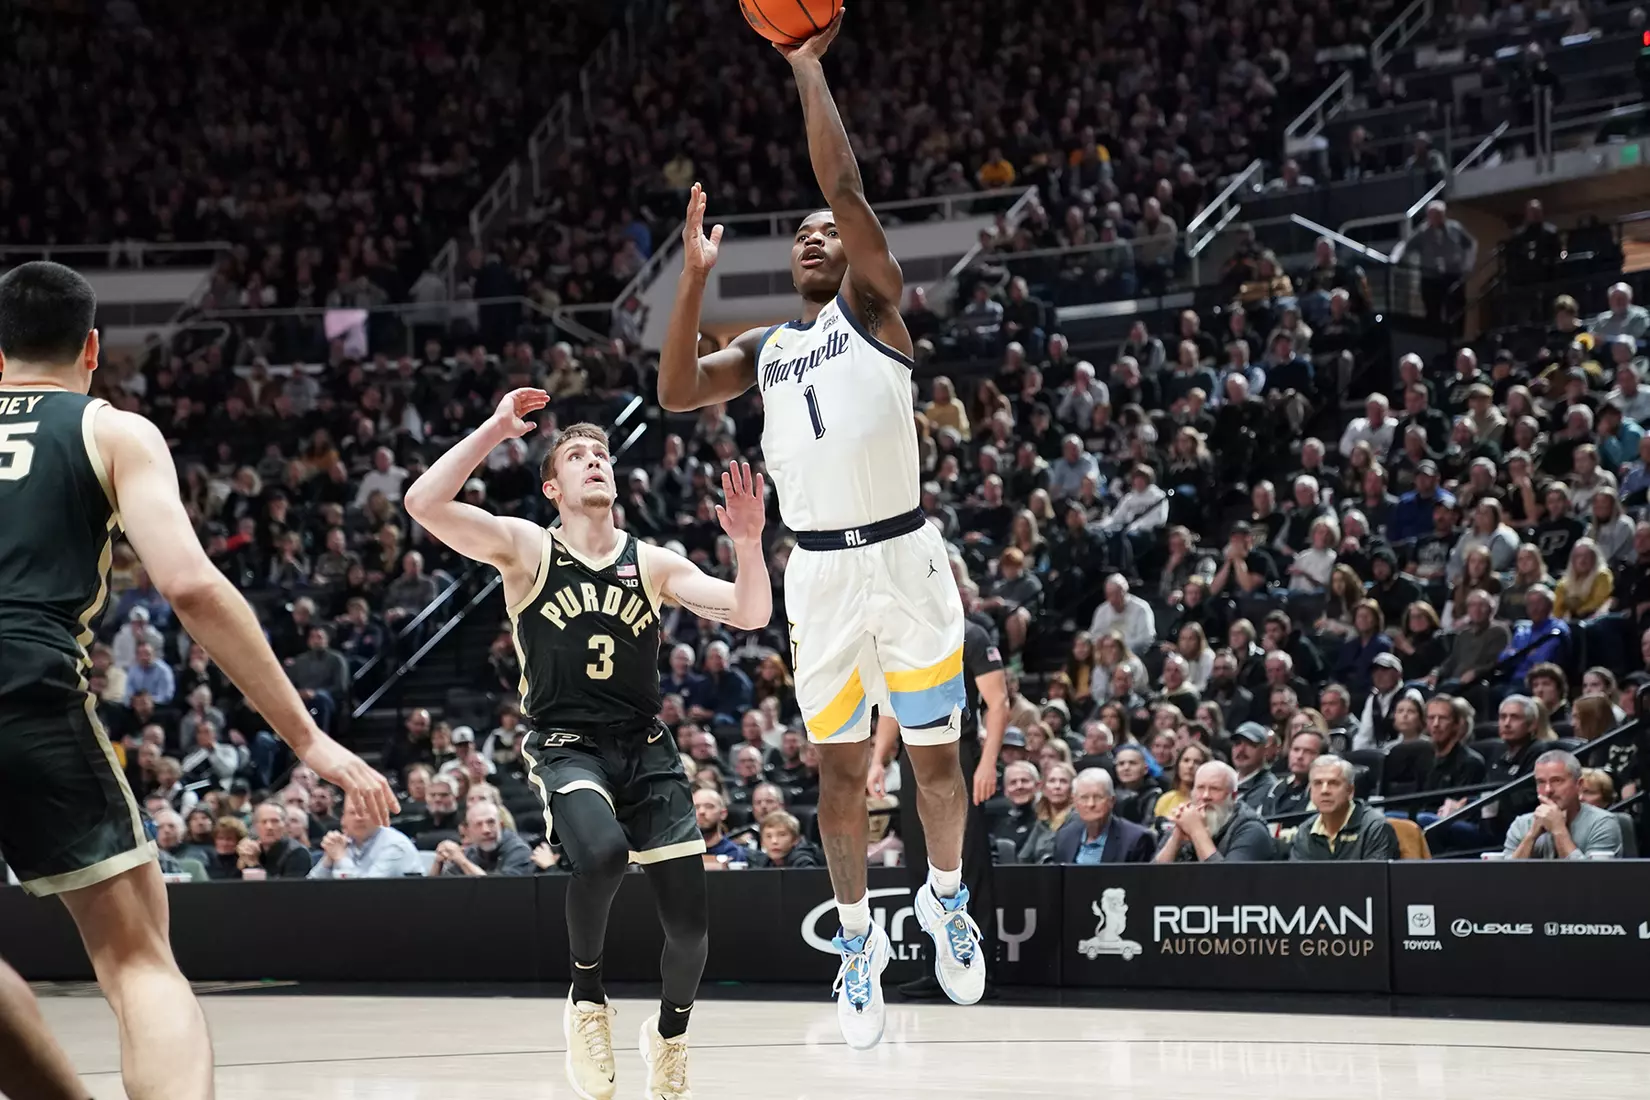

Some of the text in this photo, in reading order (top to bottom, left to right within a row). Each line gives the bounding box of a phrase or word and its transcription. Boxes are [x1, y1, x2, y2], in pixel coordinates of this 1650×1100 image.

[762, 329, 849, 391] Marquette
[804, 384, 826, 440] 1
[0, 420, 40, 481] 5
[540, 582, 653, 638] PURDUE
[586, 634, 615, 680] 3
[1153, 897, 1373, 942] ROHRMAN
[1473, 923, 1534, 935] LEXUS
[1559, 924, 1627, 936] HONDA
[1160, 937, 1374, 957] AUTOMOTIVE GROUP
[1403, 940, 1443, 951] TOYOTA
